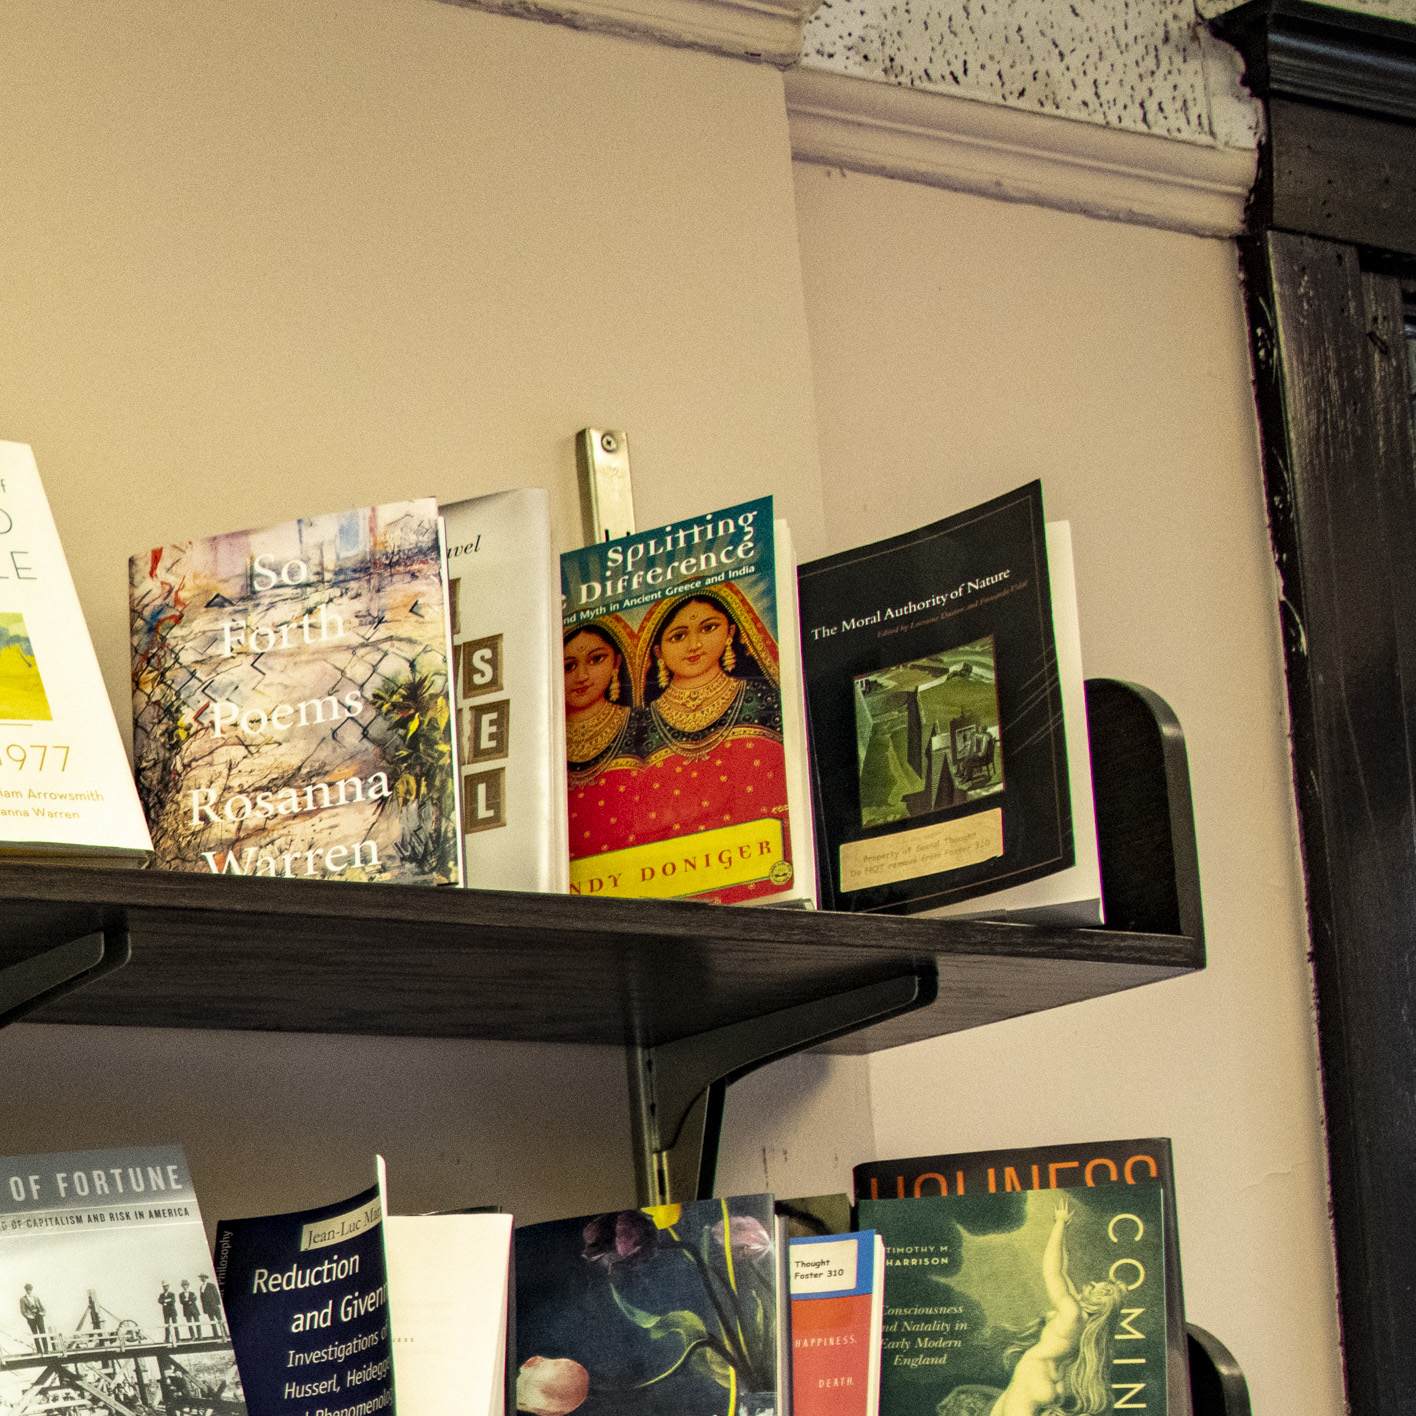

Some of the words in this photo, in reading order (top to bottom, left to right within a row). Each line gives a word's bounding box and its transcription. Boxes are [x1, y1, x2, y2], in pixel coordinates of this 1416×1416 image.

[606, 509, 759, 571] Splitting
[252, 553, 308, 592] So
[579, 538, 755, 608] Difference
[810, 623, 838, 642] The
[841, 608, 881, 633] Moral
[884, 592, 948, 625] Authority
[949, 583, 964, 602] of
[967, 566, 1011, 595] Nature
[222, 603, 346, 660] Forth
[211, 687, 364, 739] Poems
[33, 807, 80, 820] Warren
[188, 770, 393, 827] Rosanna
[201, 839, 383, 878] Warren
[640, 839, 773, 884] DONIGER
[11, 1175, 42, 1203] OF
[56, 1164, 184, 1199] FORTUNE
[252, 1252, 360, 1295] Reduction
[794, 1269, 823, 1281] Foster
[827, 1268, 845, 1278] 310
[795, 1258, 830, 1270] Thought
[885, 1256, 949, 1267] HARRISON
